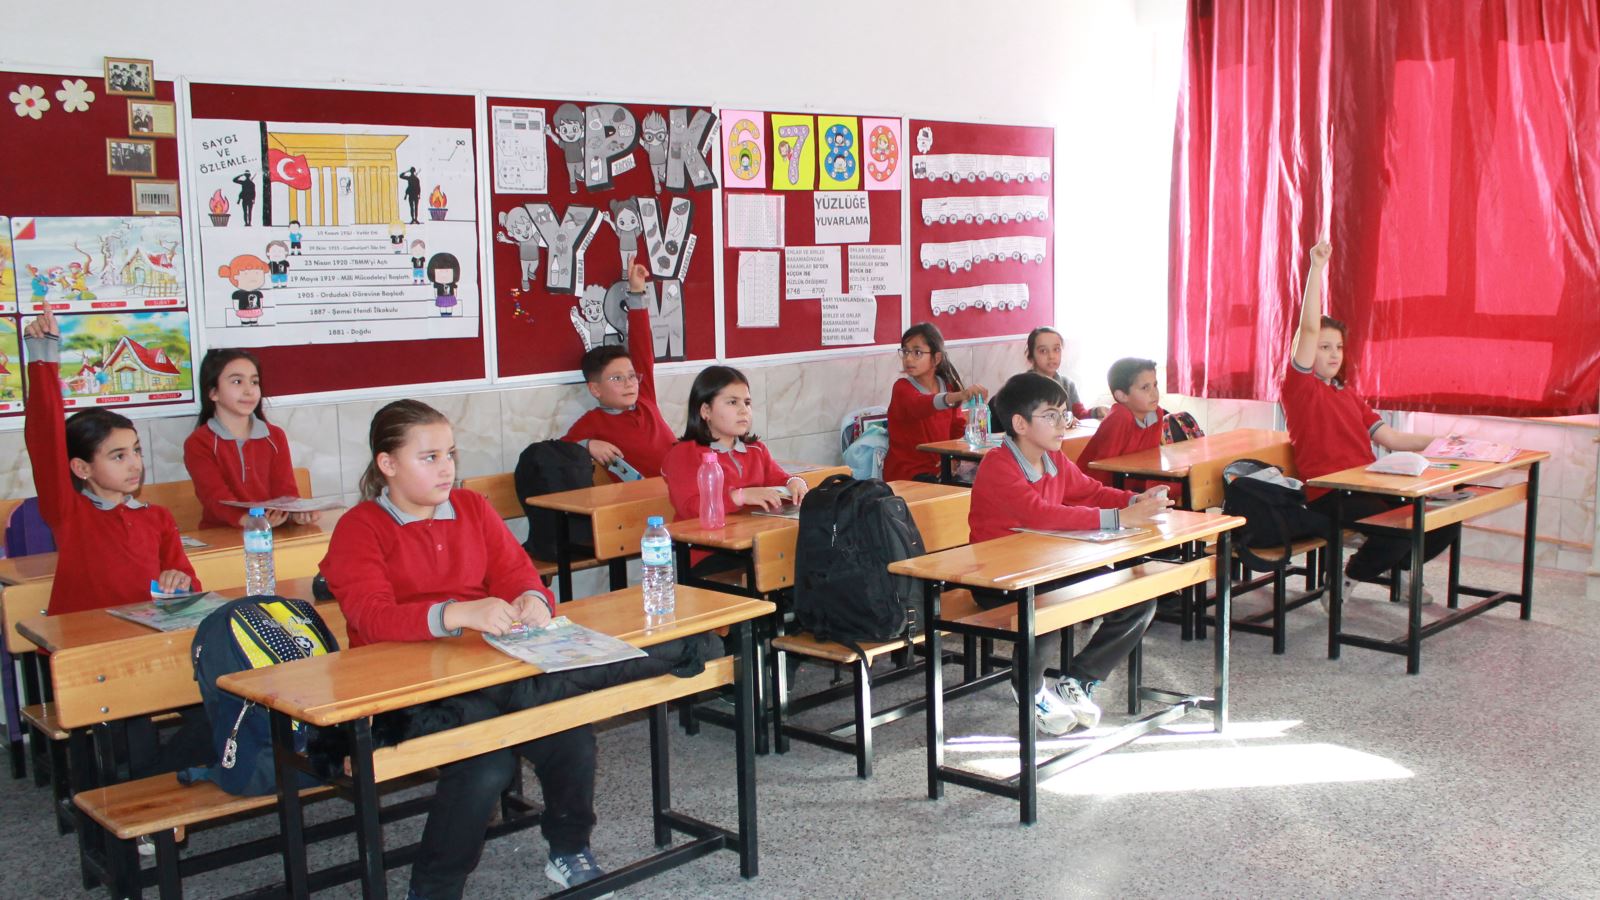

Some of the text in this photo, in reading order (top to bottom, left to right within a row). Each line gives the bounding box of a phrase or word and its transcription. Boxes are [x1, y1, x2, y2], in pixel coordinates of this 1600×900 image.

[202, 134, 238, 150] SAYGI
[216, 148, 231, 158] VE
[728, 118, 762, 181] 6
[778, 124, 810, 185] 7
[824, 123, 856, 182] 8
[867, 125, 899, 182] 9
[815, 195, 866, 210] YÜZLÜĞE
[816, 216, 869, 226] YUVARLAMA
